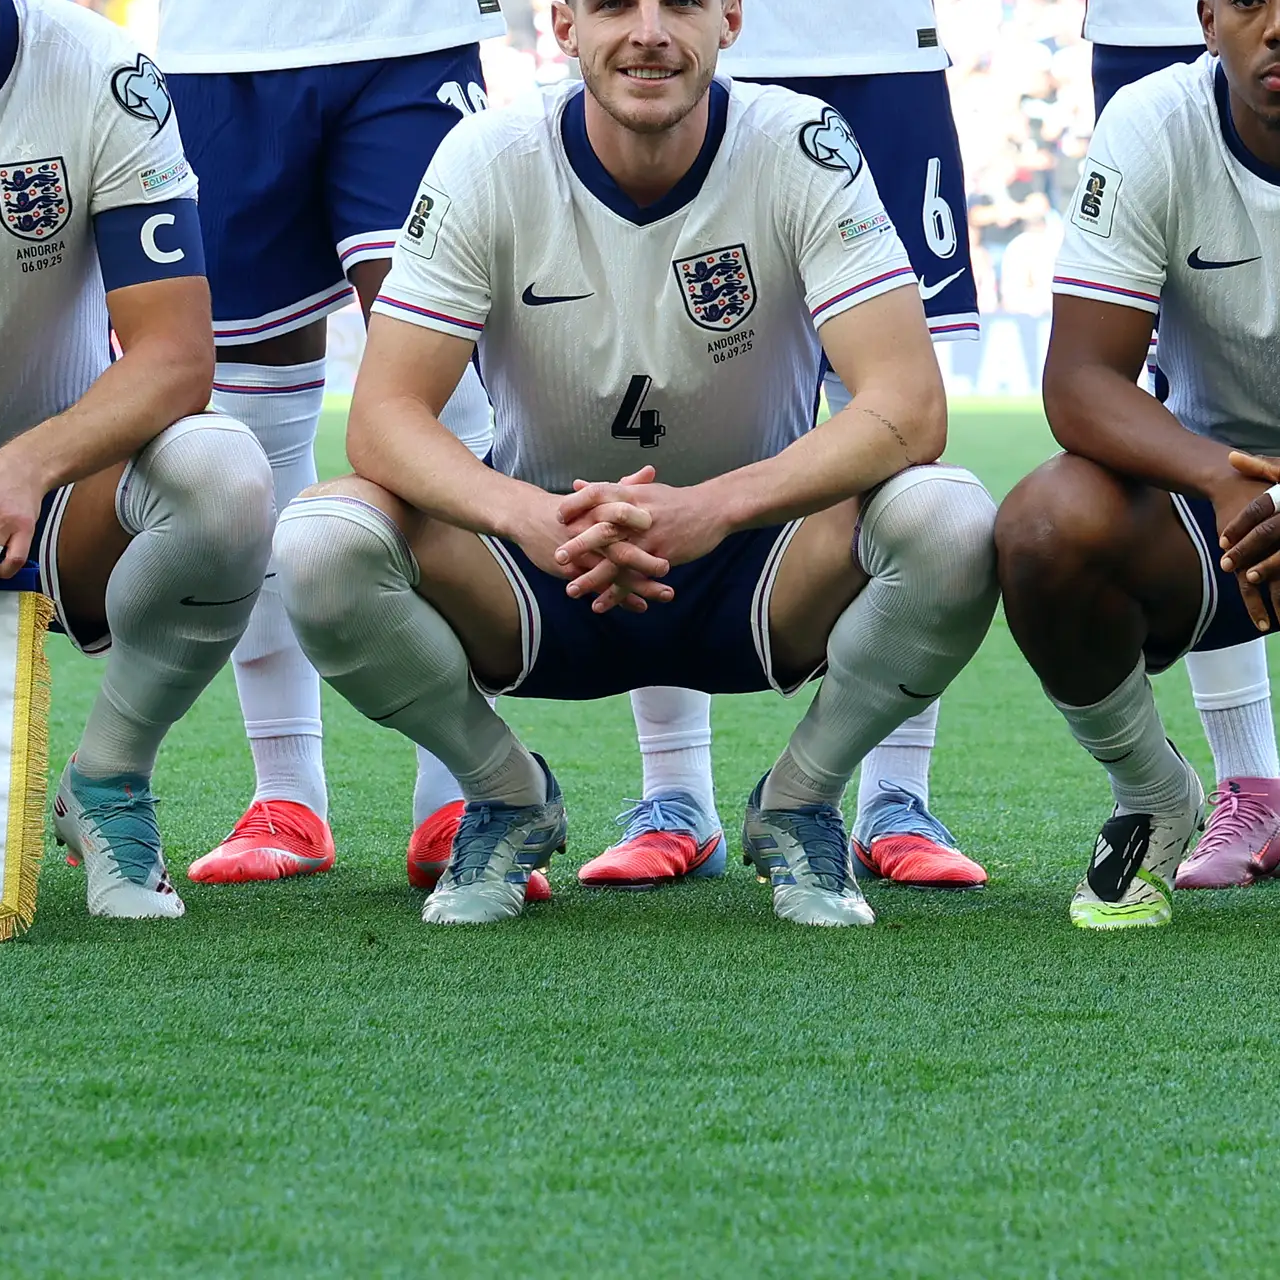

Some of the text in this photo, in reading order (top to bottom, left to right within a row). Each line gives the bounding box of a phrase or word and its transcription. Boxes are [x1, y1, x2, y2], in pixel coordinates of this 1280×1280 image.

[143, 161, 187, 188] FOUNDATIO
[923, 157, 957, 259] 6
[16, 240, 65, 260] ANDORRA
[140, 213, 185, 264] C
[21, 253, 62, 273] 06.09.25
[707, 329, 755, 353] ANDORRA
[713, 340, 753, 364] 06.09.25
[611, 374, 666, 449] 4
